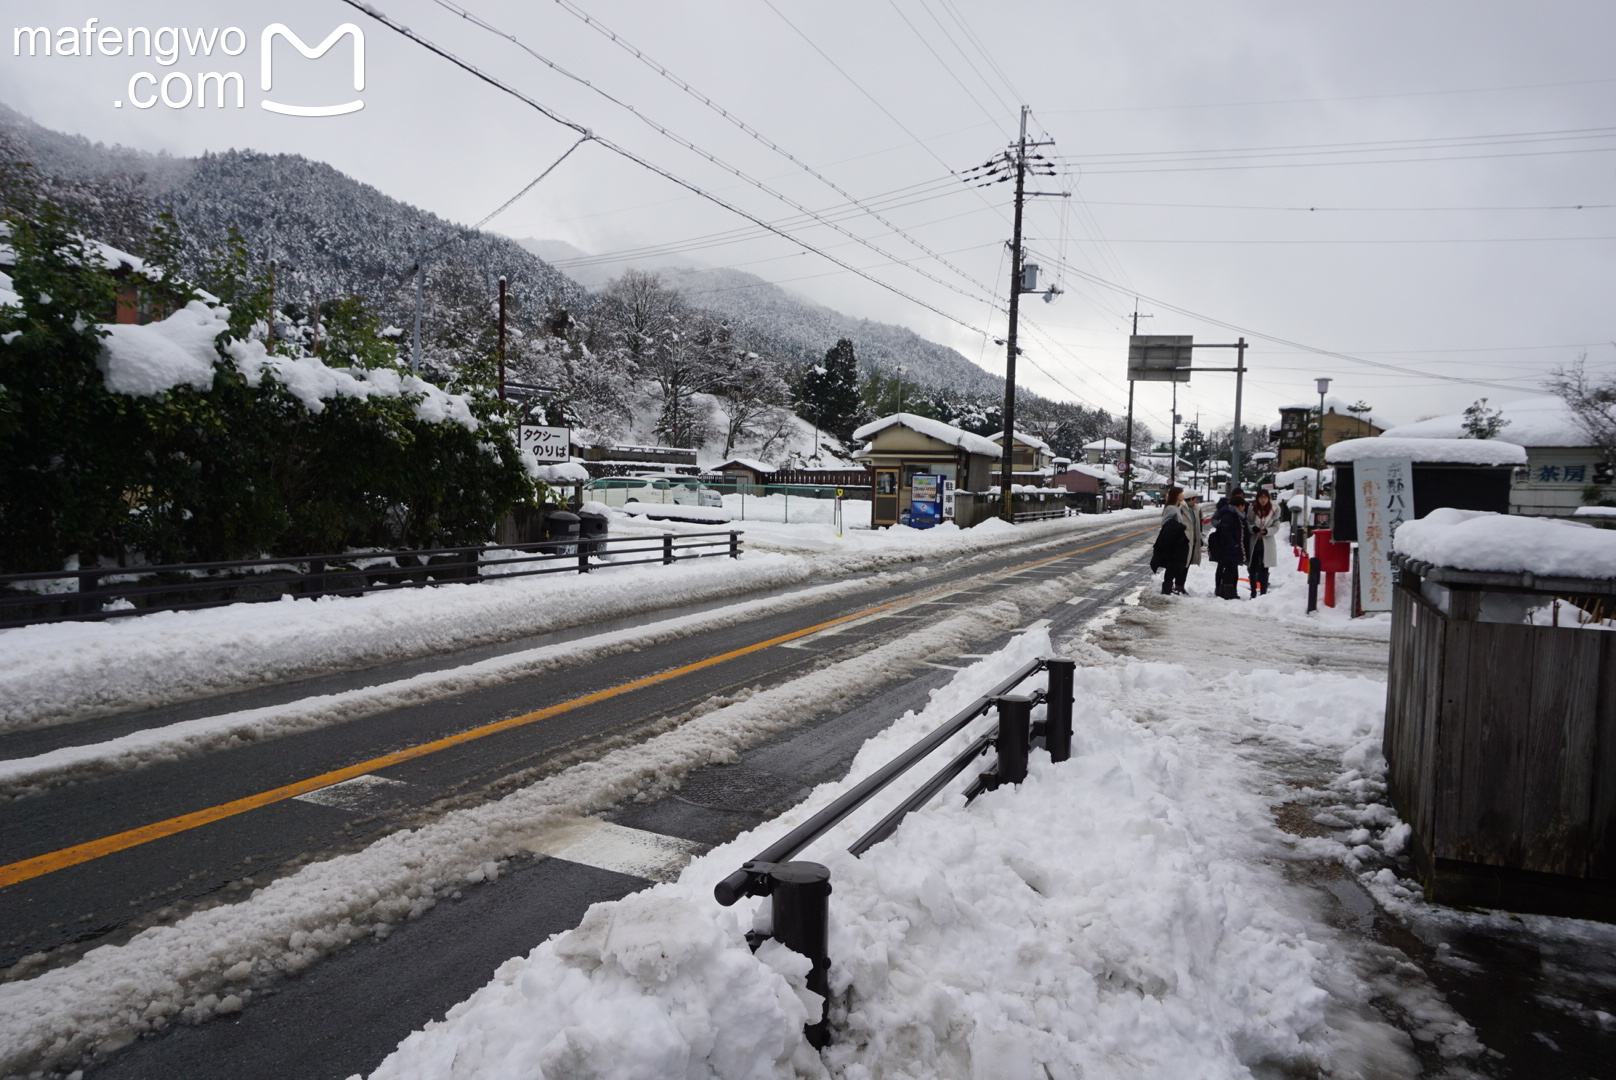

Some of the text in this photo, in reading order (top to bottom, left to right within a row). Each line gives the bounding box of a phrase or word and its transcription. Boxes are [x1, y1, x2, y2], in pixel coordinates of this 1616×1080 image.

[524, 429, 561, 442] タクシー
[533, 445, 567, 457] のりば
[1538, 465, 1586, 483] 茶房
[945, 481, 954, 516] 駐車場
